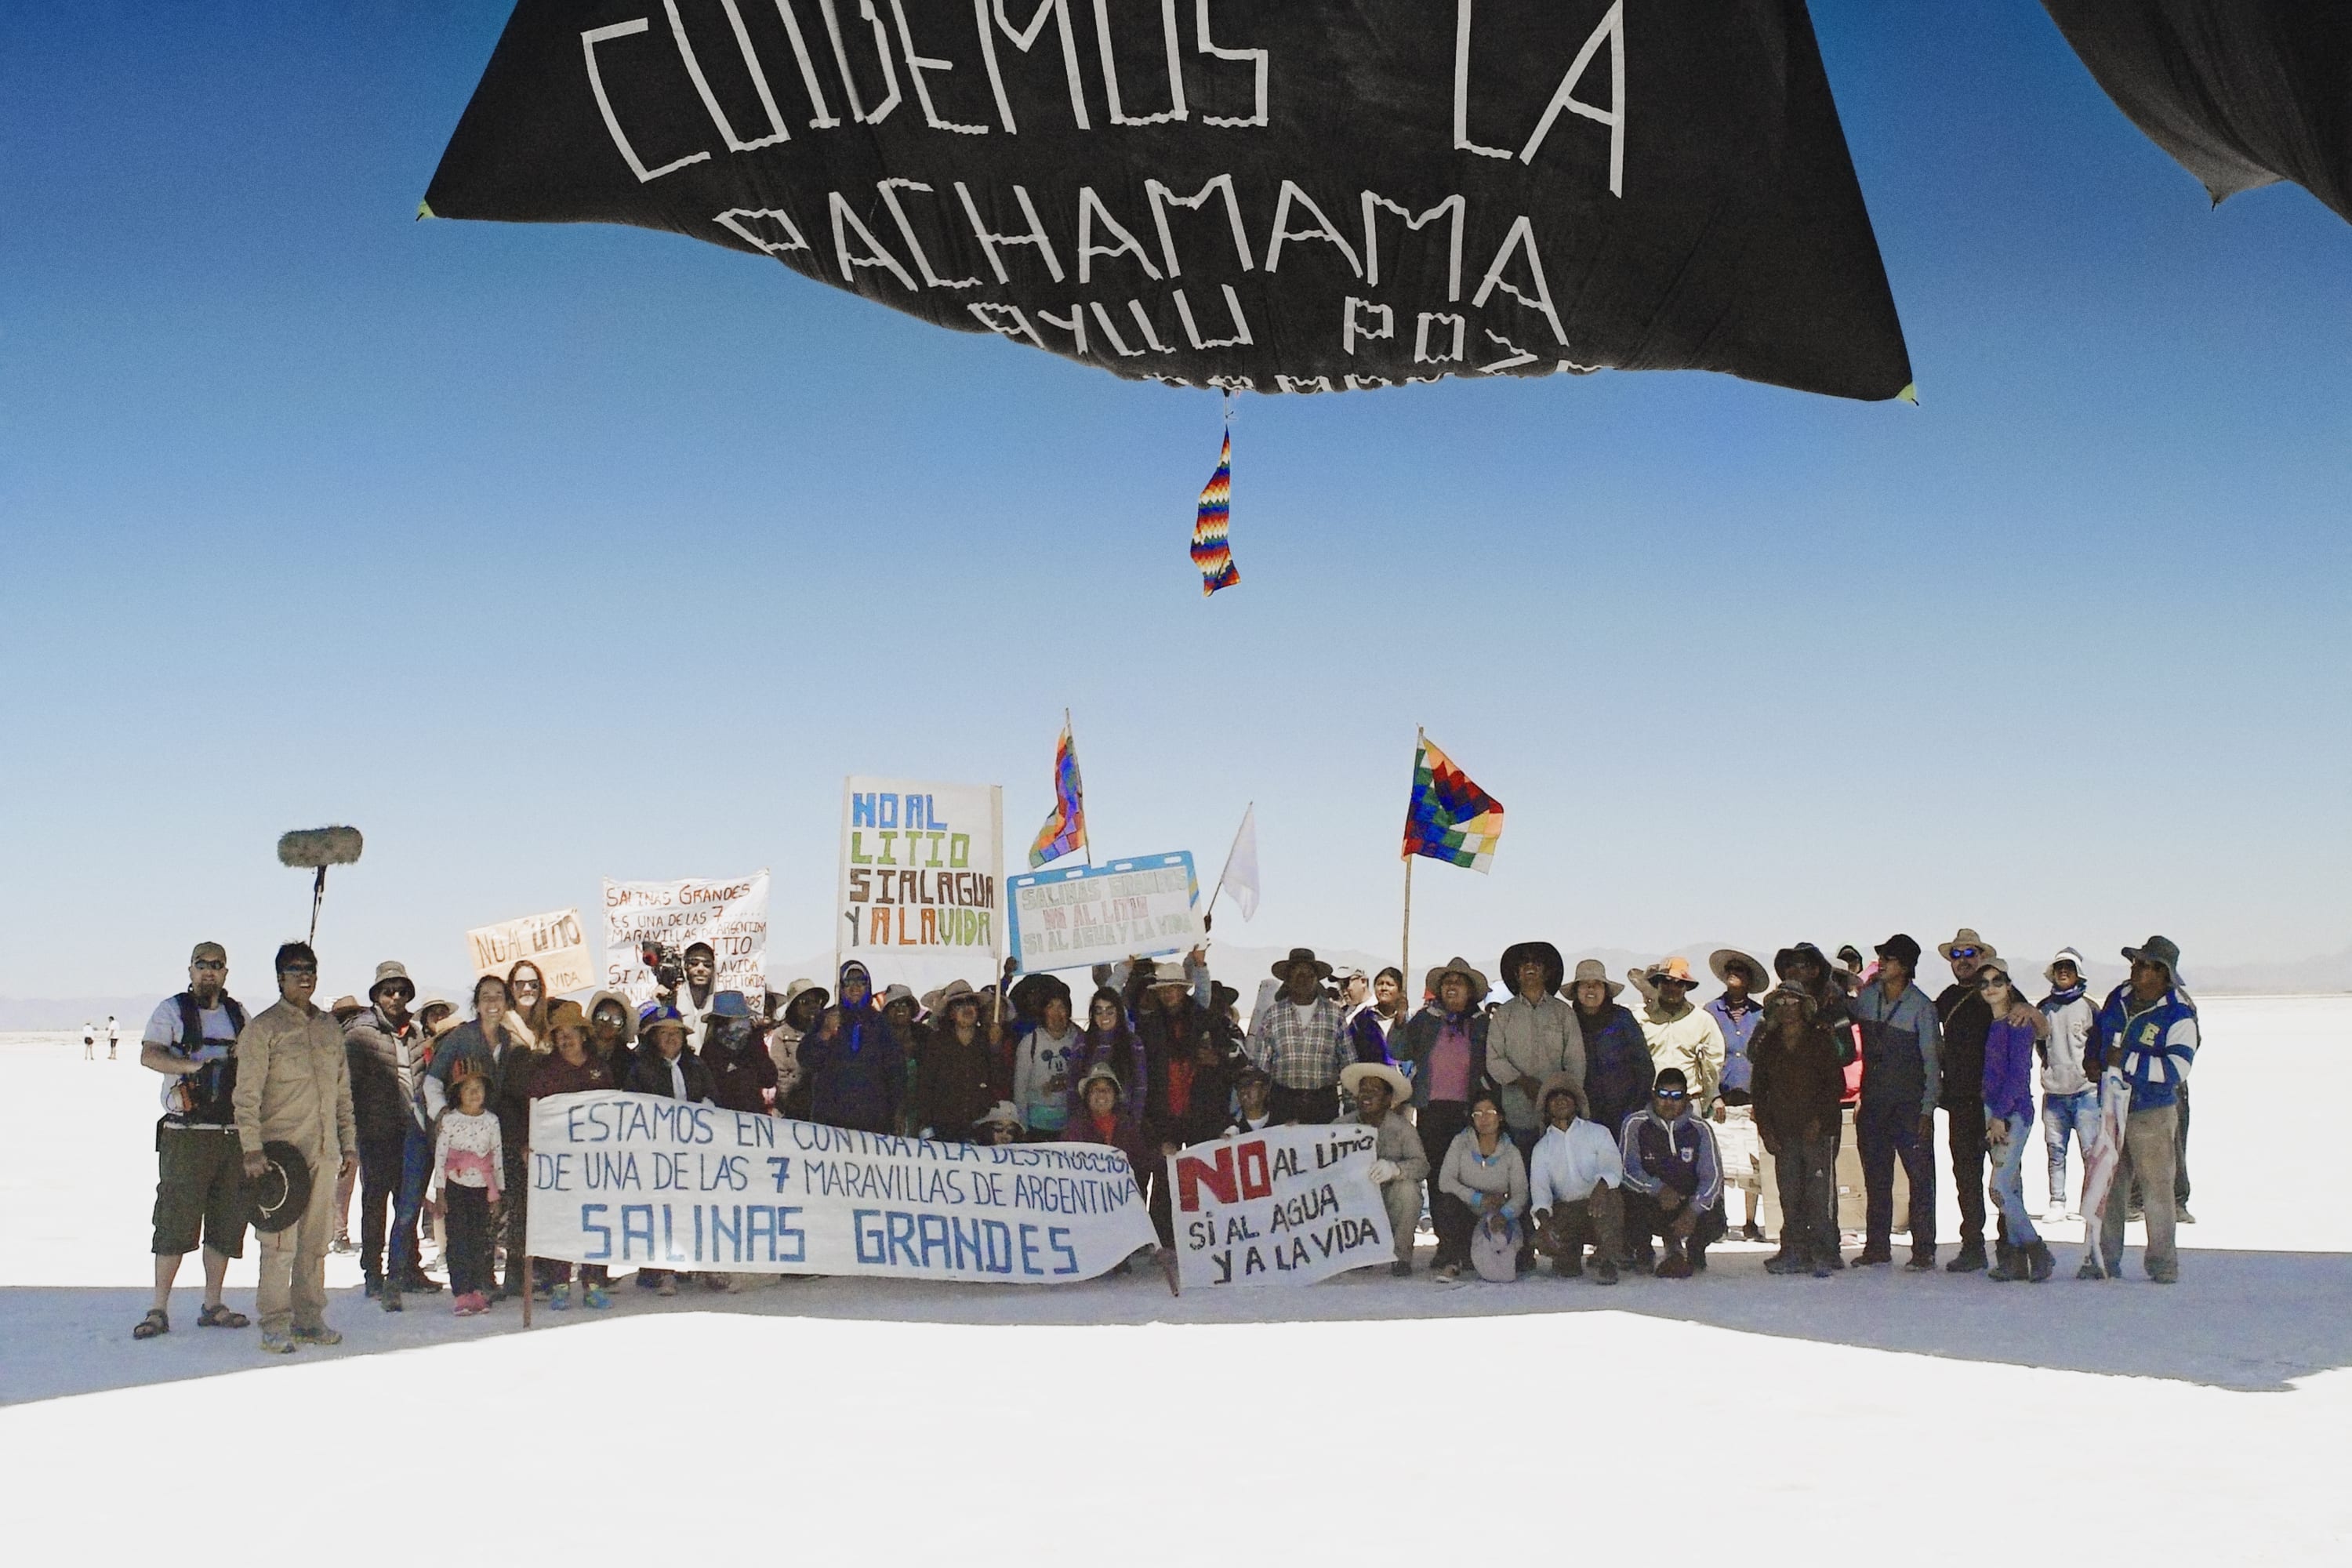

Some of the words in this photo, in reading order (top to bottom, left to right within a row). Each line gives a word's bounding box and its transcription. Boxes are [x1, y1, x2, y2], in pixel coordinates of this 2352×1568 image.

[1454, 0, 1624, 198] LA
[713, 174, 1569, 347] PACHAMAMA
[853, 793, 898, 829] NO
[906, 794, 948, 830] AL
[851, 831, 970, 868] LITIO
[679, 884, 750, 905] GRANDES
[850, 868, 896, 904] SI
[898, 869, 934, 904] AL
[938, 872, 993, 909] AGUA
[1022, 879, 1102, 910] SALINAS
[611, 913, 630, 928] ES
[637, 915, 663, 927] UNA
[712, 906, 723, 921] 7
[844, 906, 860, 946] Y
[870, 907, 890, 946] A
[938, 908, 991, 946] VIDA
[1073, 903, 1096, 927] AL
[476, 934, 506, 968] NO
[508, 927, 527, 961] AL
[612, 928, 696, 942] MARAVILLAS
[710, 936, 752, 956] ITIO
[1048, 929, 1069, 952] AL
[550, 971, 582, 988] VIDA
[608, 964, 631, 985] SI
[2139, 1022, 2161, 1047] E
[568, 1101, 713, 1145] ESTAMOS
[735, 1112, 775, 1149] EN
[793, 1122, 912, 1157] CONTRA
[534, 1152, 572, 1191] DE
[585, 1152, 641, 1191] UNA
[653, 1152, 689, 1191] DE
[700, 1154, 750, 1191] LAS
[767, 1156, 789, 1193] 7
[804, 1159, 964, 1204] MARAVILLAS
[973, 1171, 1007, 1207] DE
[1014, 1173, 1142, 1214] ARGENTINA
[1177, 1140, 1272, 1212] NO
[1272, 1147, 1308, 1181] AL
[1226, 1215, 1260, 1245] AL
[1270, 1184, 1339, 1234] AGUA
[581, 1203, 805, 1263] SALINAS
[852, 1207, 1079, 1275] GRANDES
[1211, 1250, 1232, 1284] Y
[1245, 1247, 1266, 1276] A
[1276, 1236, 1310, 1271] LA
